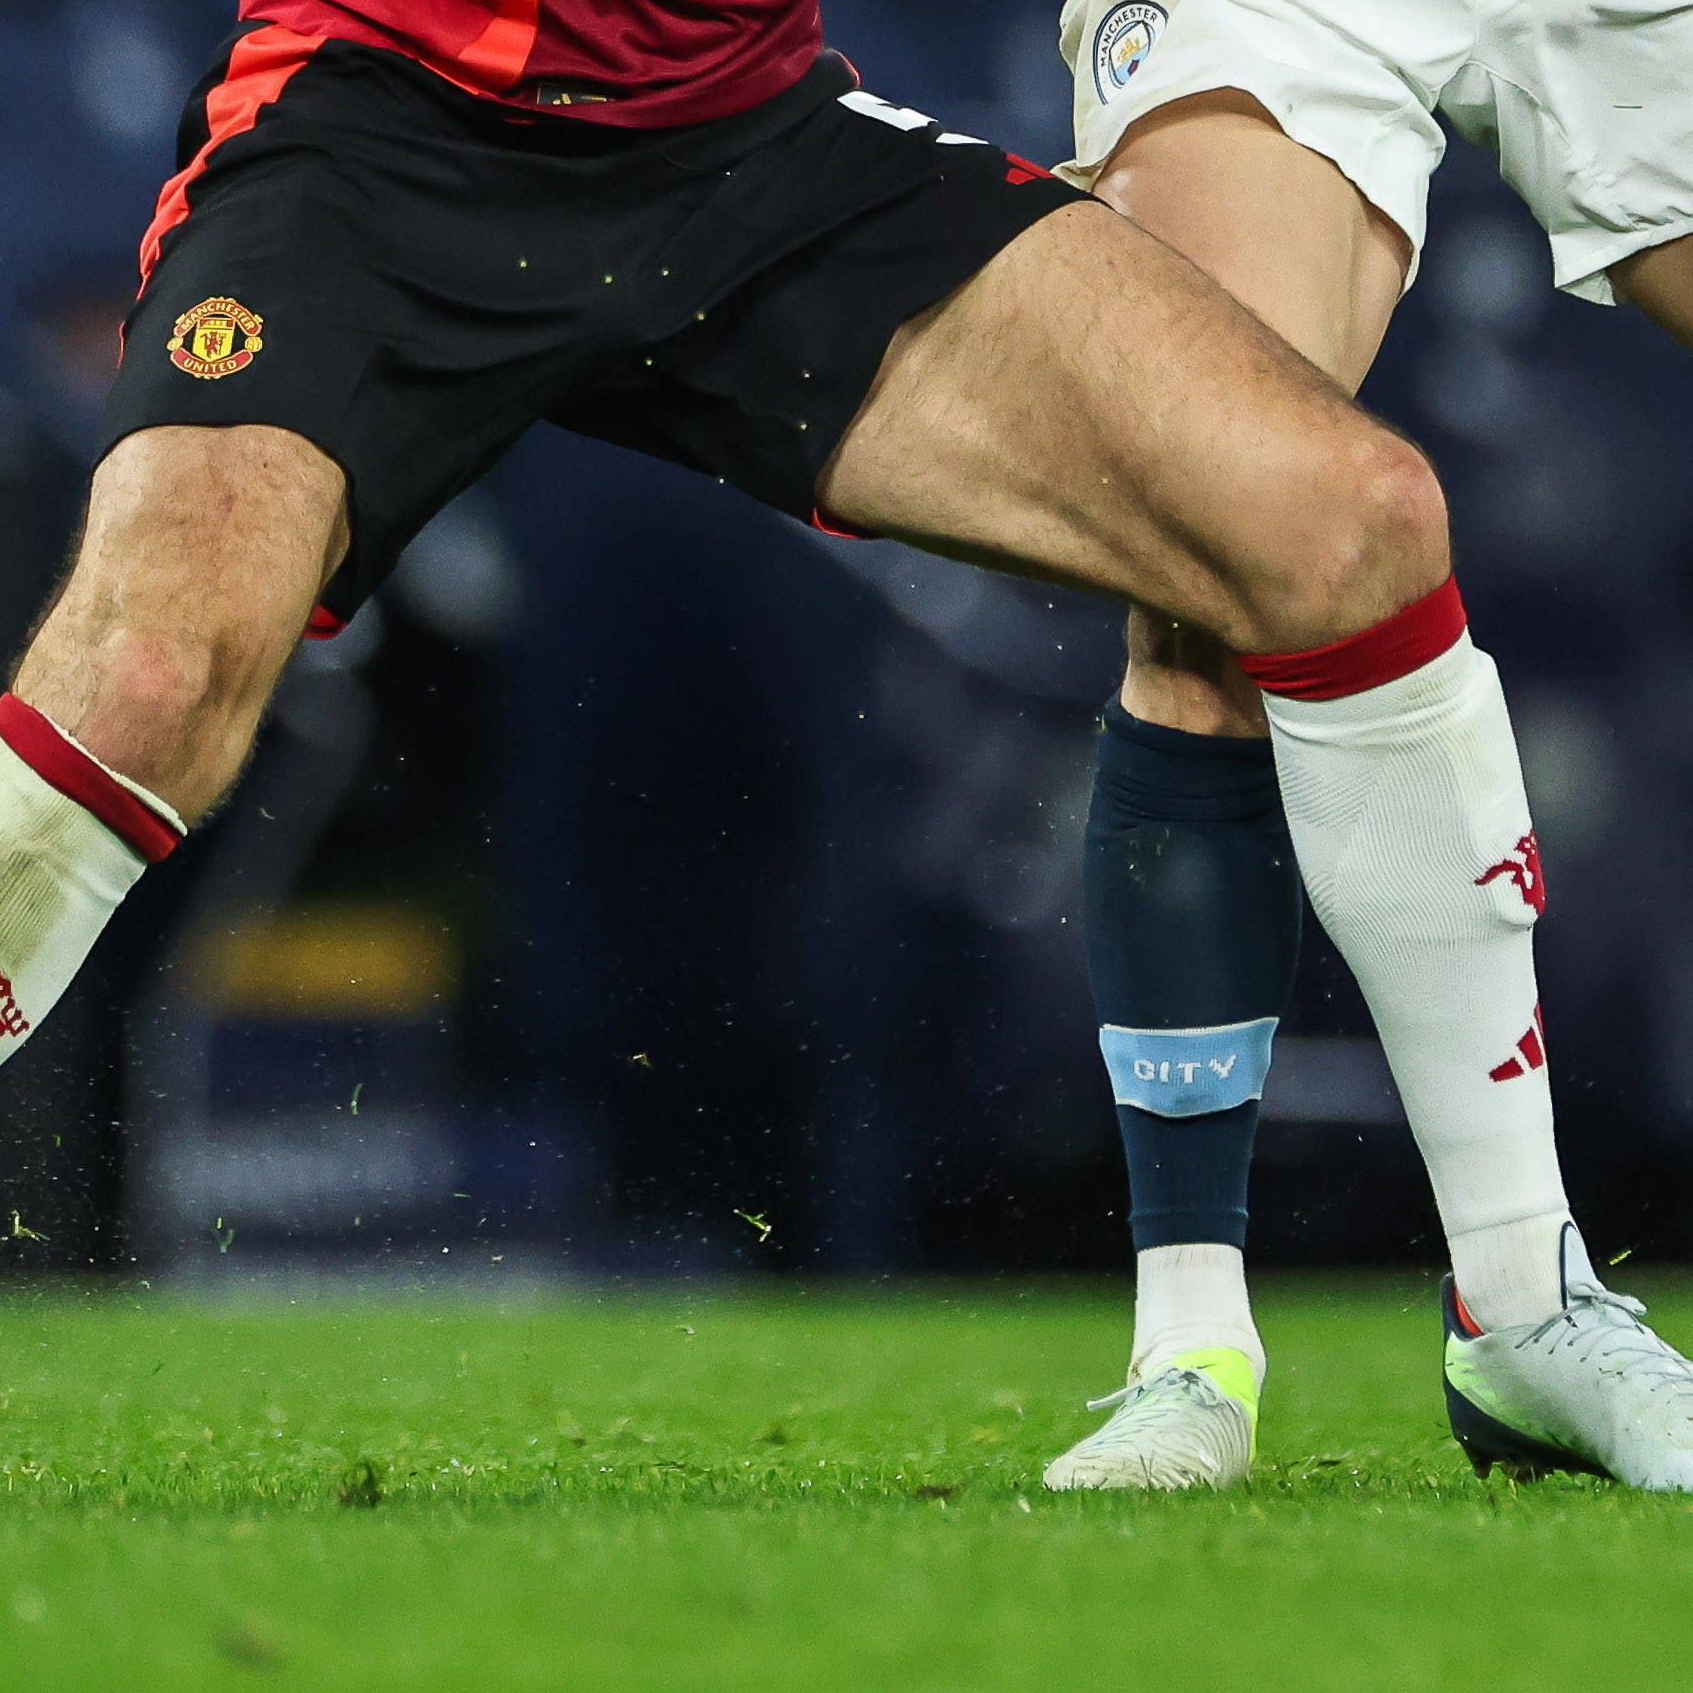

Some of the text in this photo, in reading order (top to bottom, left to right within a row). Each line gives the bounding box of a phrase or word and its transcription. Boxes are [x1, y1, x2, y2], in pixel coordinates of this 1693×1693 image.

[1100, 7, 1158, 68] MANCHESTER
[180, 301, 256, 331] MANCHESTER
[183, 356, 238, 374] UNITED
[1133, 1054, 1238, 1085] CITY
